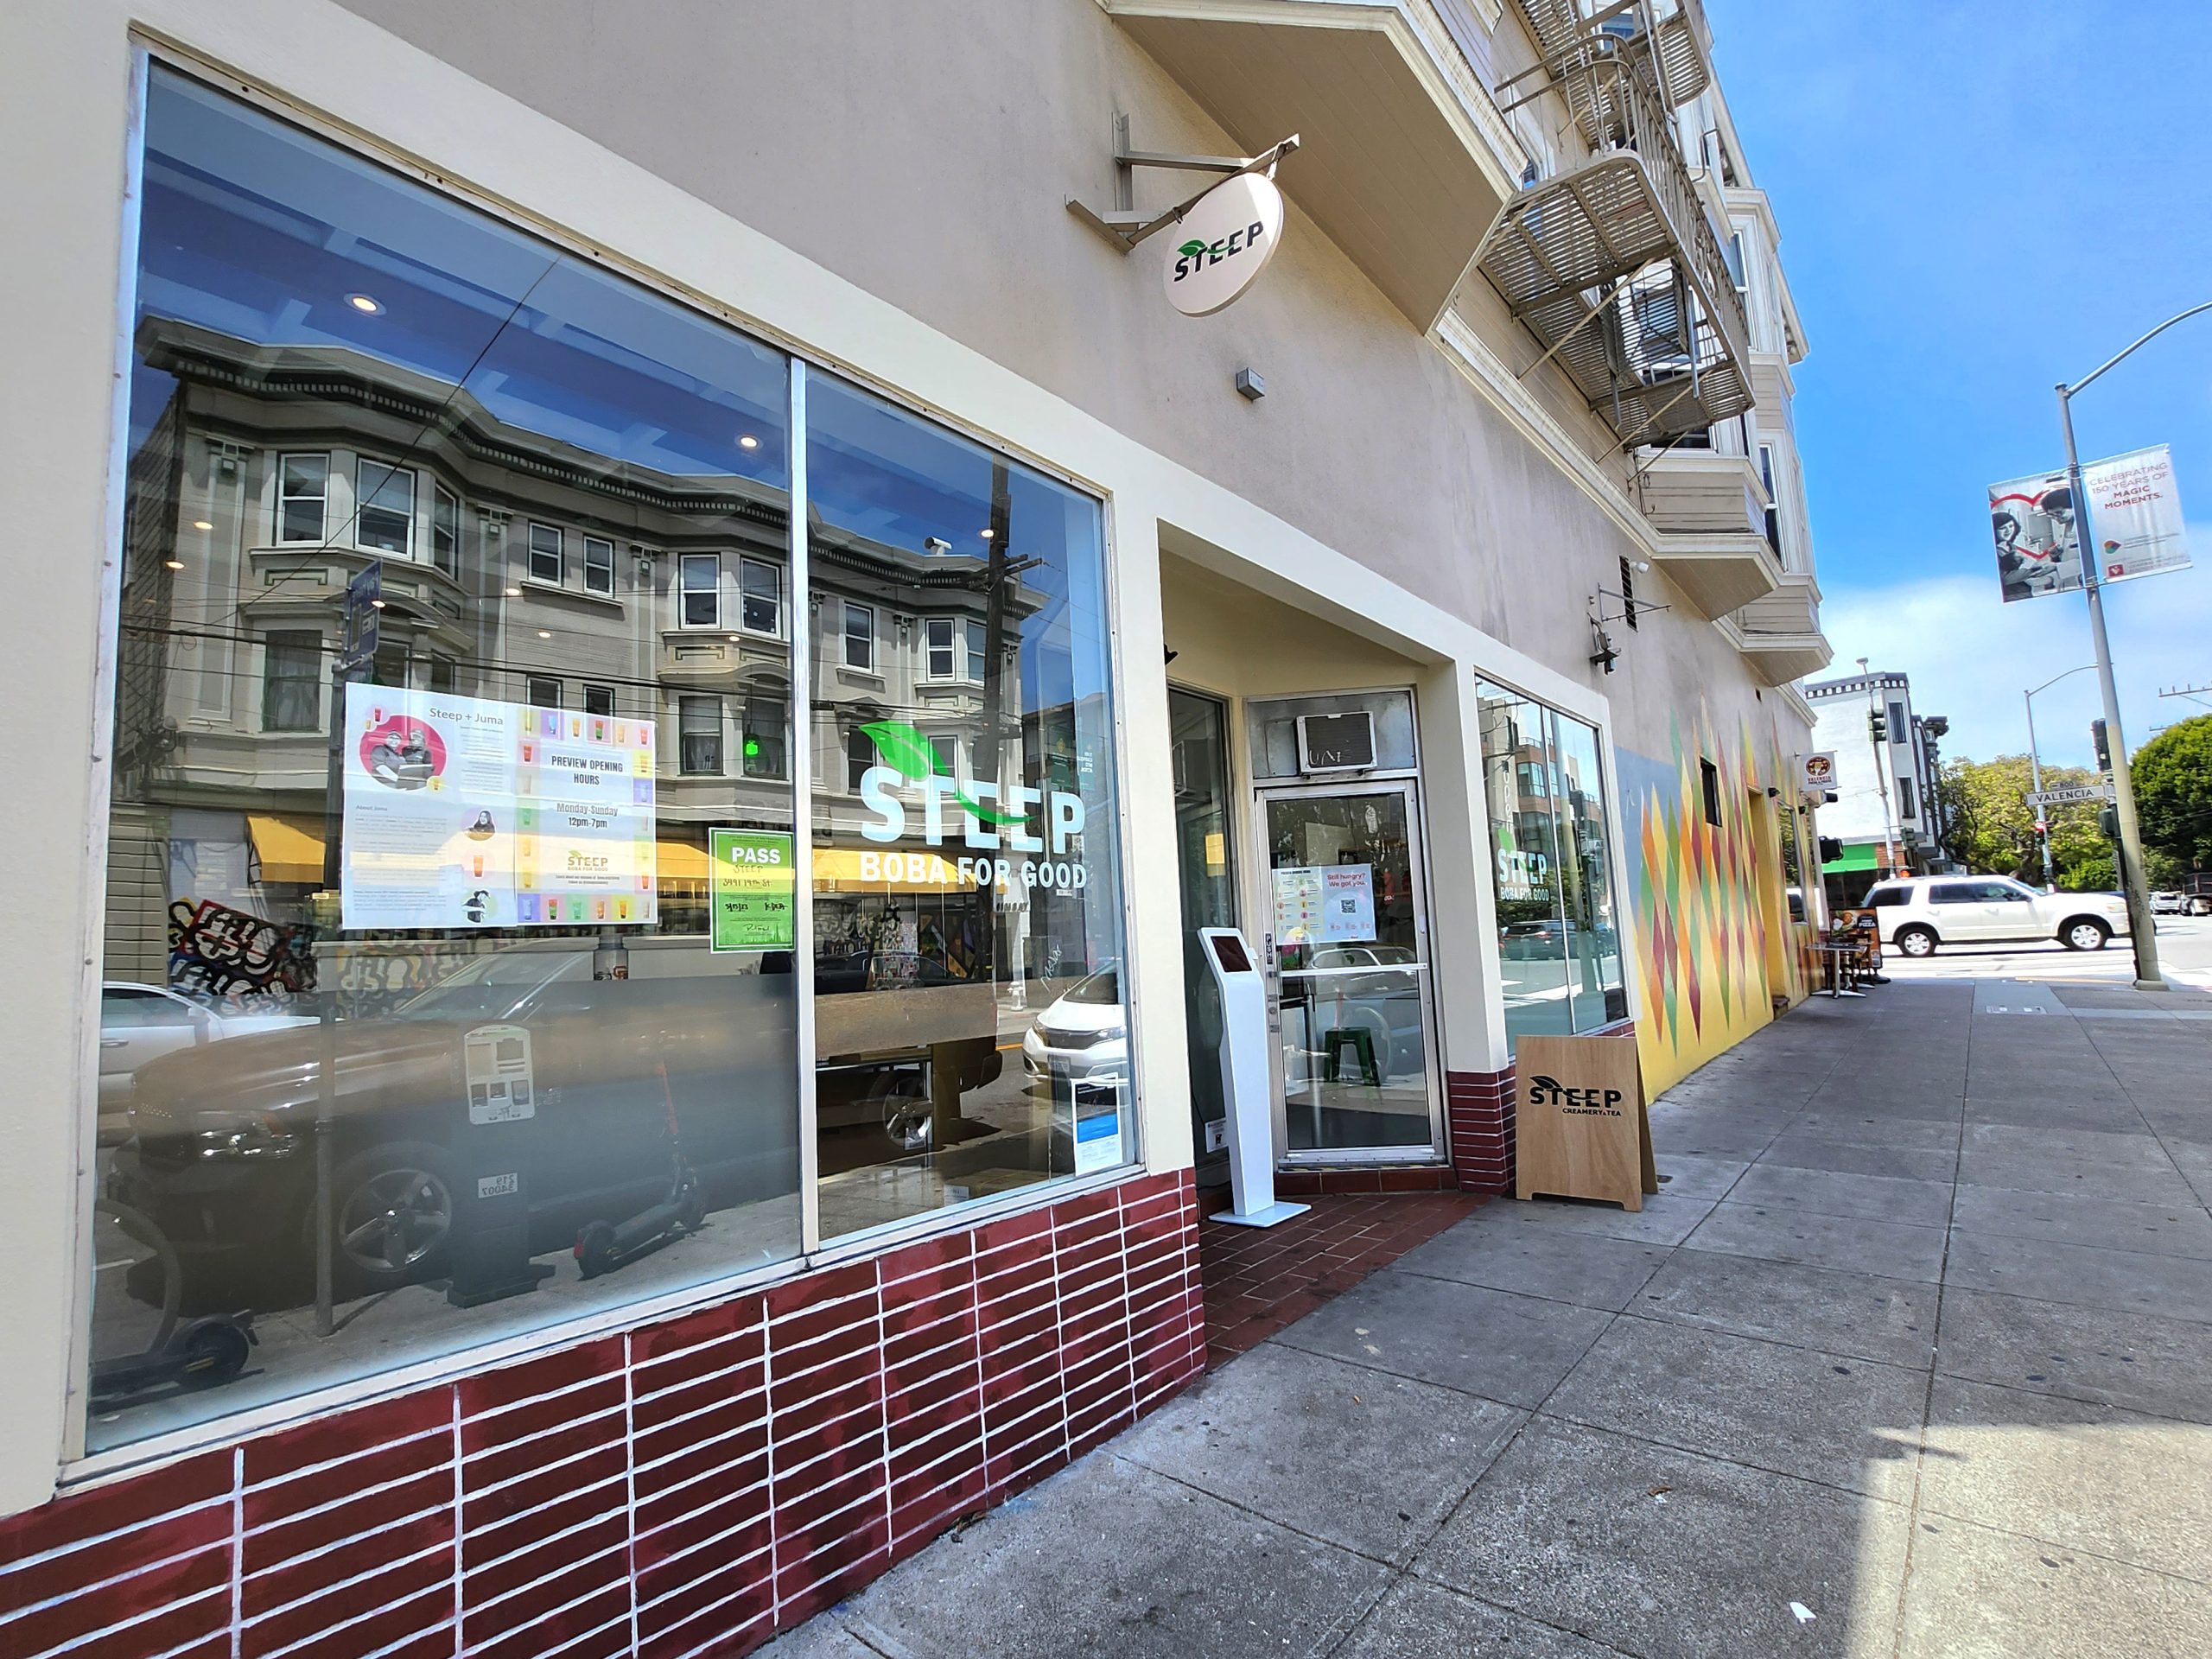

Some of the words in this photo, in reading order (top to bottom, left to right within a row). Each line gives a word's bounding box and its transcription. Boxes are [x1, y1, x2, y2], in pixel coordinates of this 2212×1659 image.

[1173, 220, 1264, 283] STEEP
[2089, 462, 2168, 486] CELEBRATING
[2092, 485, 2110, 494] 150
[2112, 475, 2150, 490] YEARS
[2152, 471, 2170, 480] OF
[2113, 485, 2151, 499] MAGIC
[2104, 492, 2164, 510] MOMENTS.
[429, 708, 463, 722] Steep
[474, 713, 504, 725] Juma
[551, 755, 588, 769] PREVIEW
[589, 760, 623, 772] OPENING
[574, 773, 601, 785] HOURS
[2036, 789, 2094, 803] VALENCIA
[556, 803, 619, 817] Monday-Sunday
[860, 766, 1085, 855] STEEP
[569, 817, 608, 829] 12pm-7pm
[568, 856, 608, 867] STEEP
[732, 847, 781, 864] PASS
[733, 864, 764, 874] STEEP
[860, 851, 948, 885] BOBA
[957, 856, 1011, 887] FOR
[1020, 860, 1088, 889] GOOD
[1497, 849, 1548, 885] STEEP
[1500, 887, 1519, 900] BOBA
[1520, 887, 1533, 900] FOR
[1534, 888, 1550, 901] GOOD
[1529, 1086, 1622, 1109] STEEP
